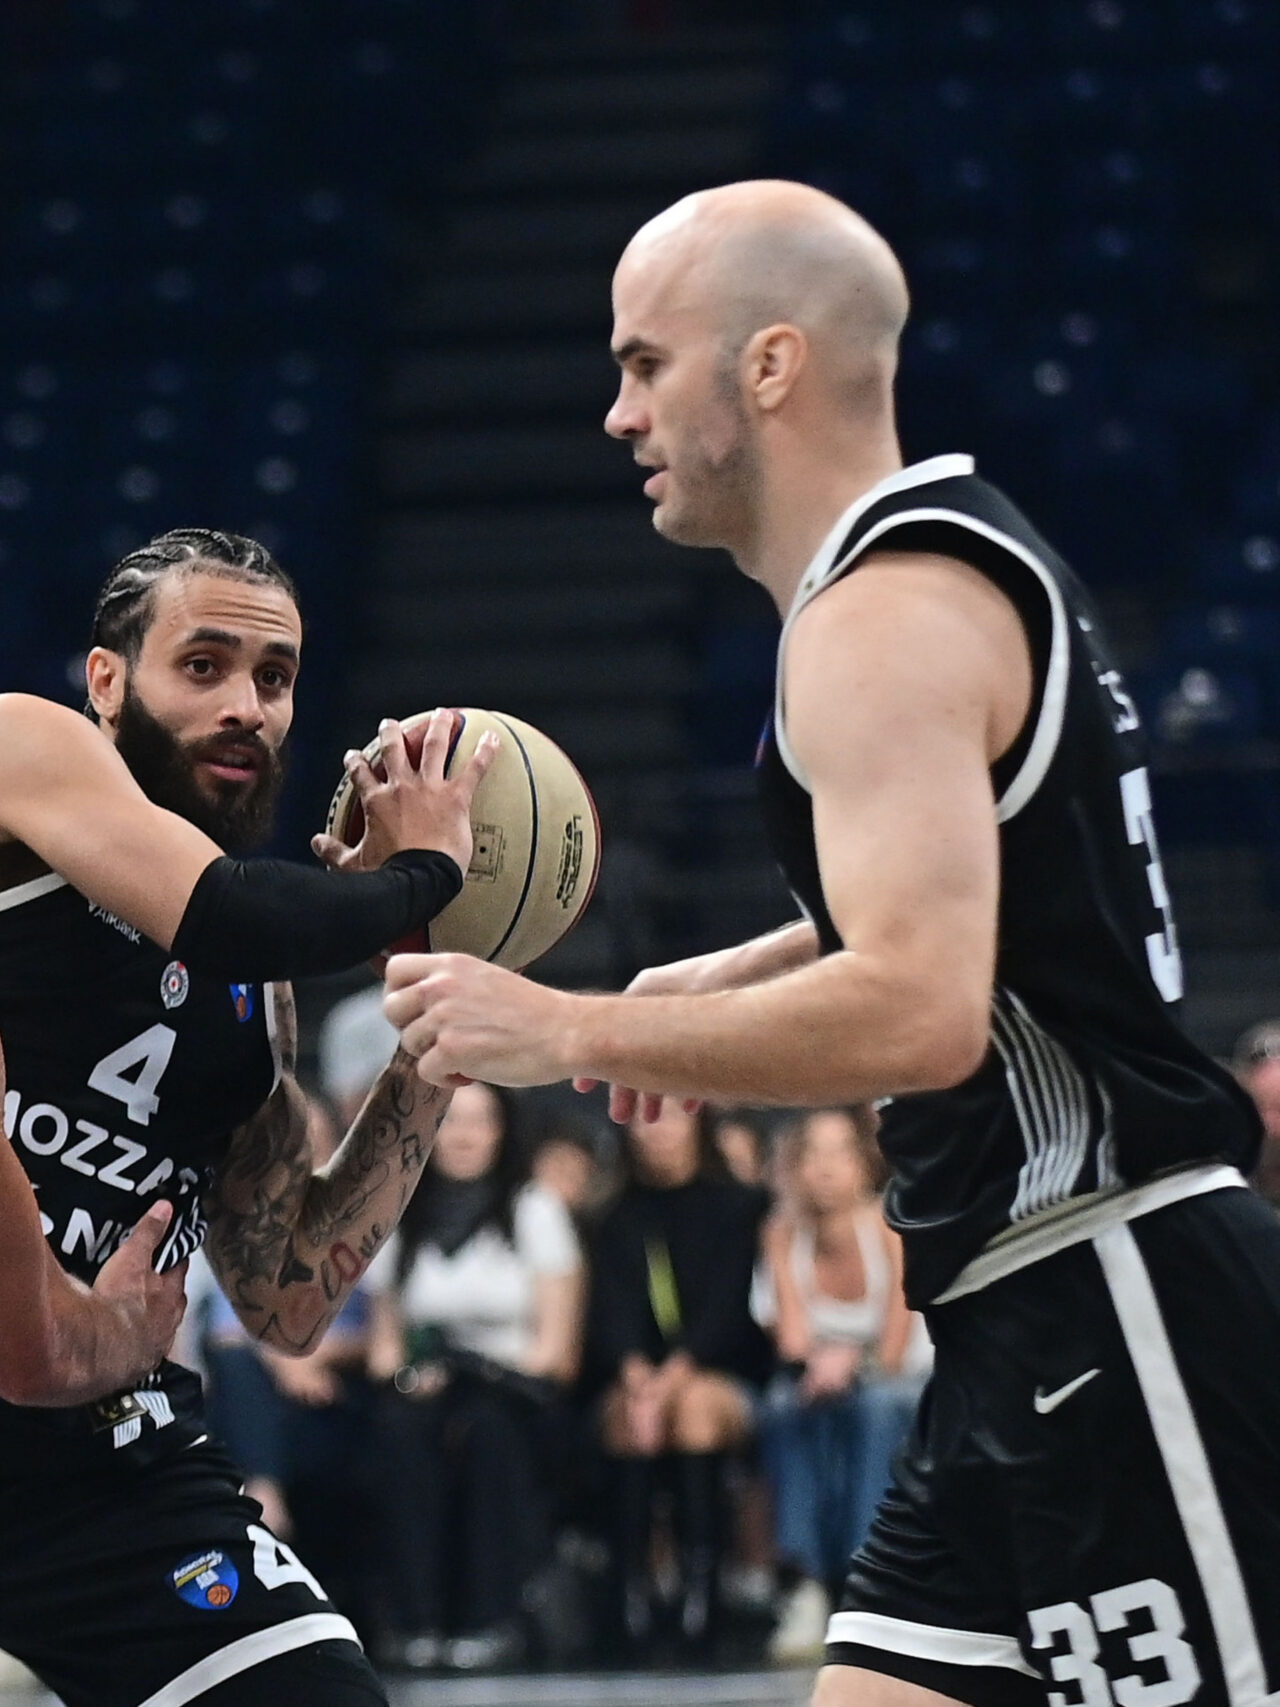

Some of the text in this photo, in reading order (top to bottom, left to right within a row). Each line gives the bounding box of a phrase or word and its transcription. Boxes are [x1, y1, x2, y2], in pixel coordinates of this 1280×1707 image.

[87, 1023, 177, 1126] 4
[247, 1524, 329, 1601] 4
[1026, 1578, 1204, 1707] 33
